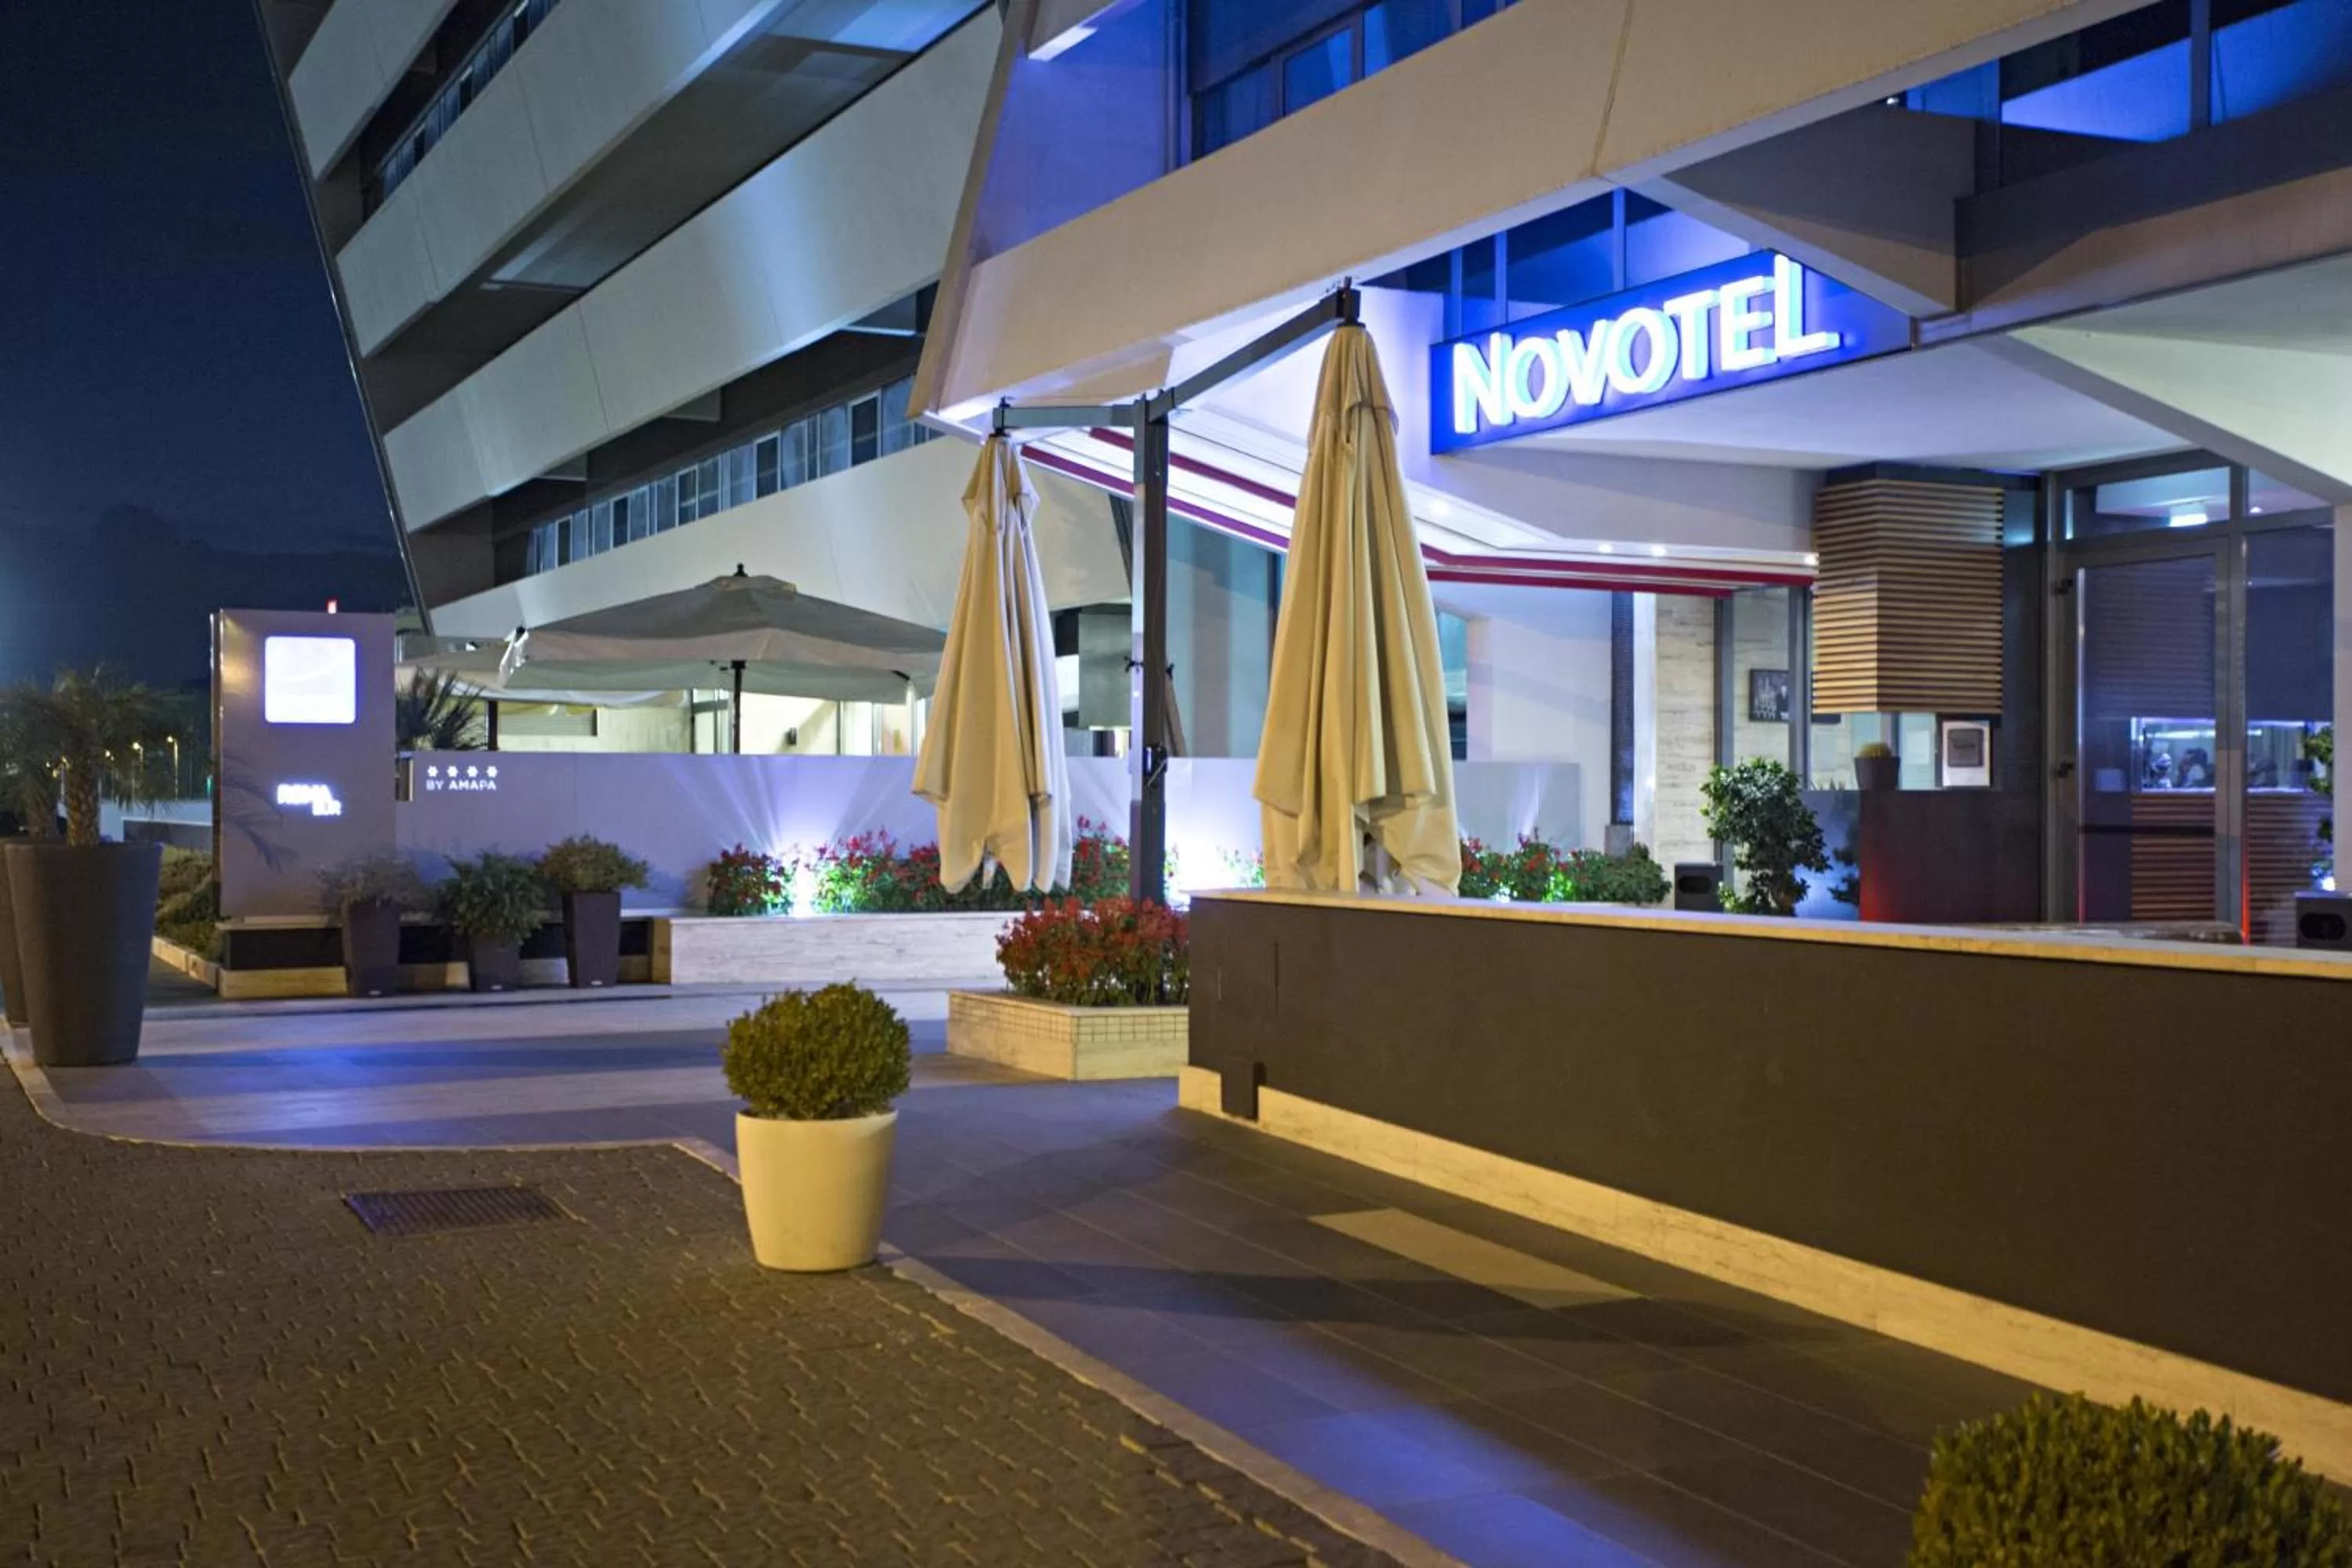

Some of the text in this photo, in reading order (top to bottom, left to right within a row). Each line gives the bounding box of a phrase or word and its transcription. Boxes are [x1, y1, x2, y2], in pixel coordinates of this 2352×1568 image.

[1453, 253, 1840, 434] NOVOTEL
[426, 779, 497, 791] BY AMAPA
